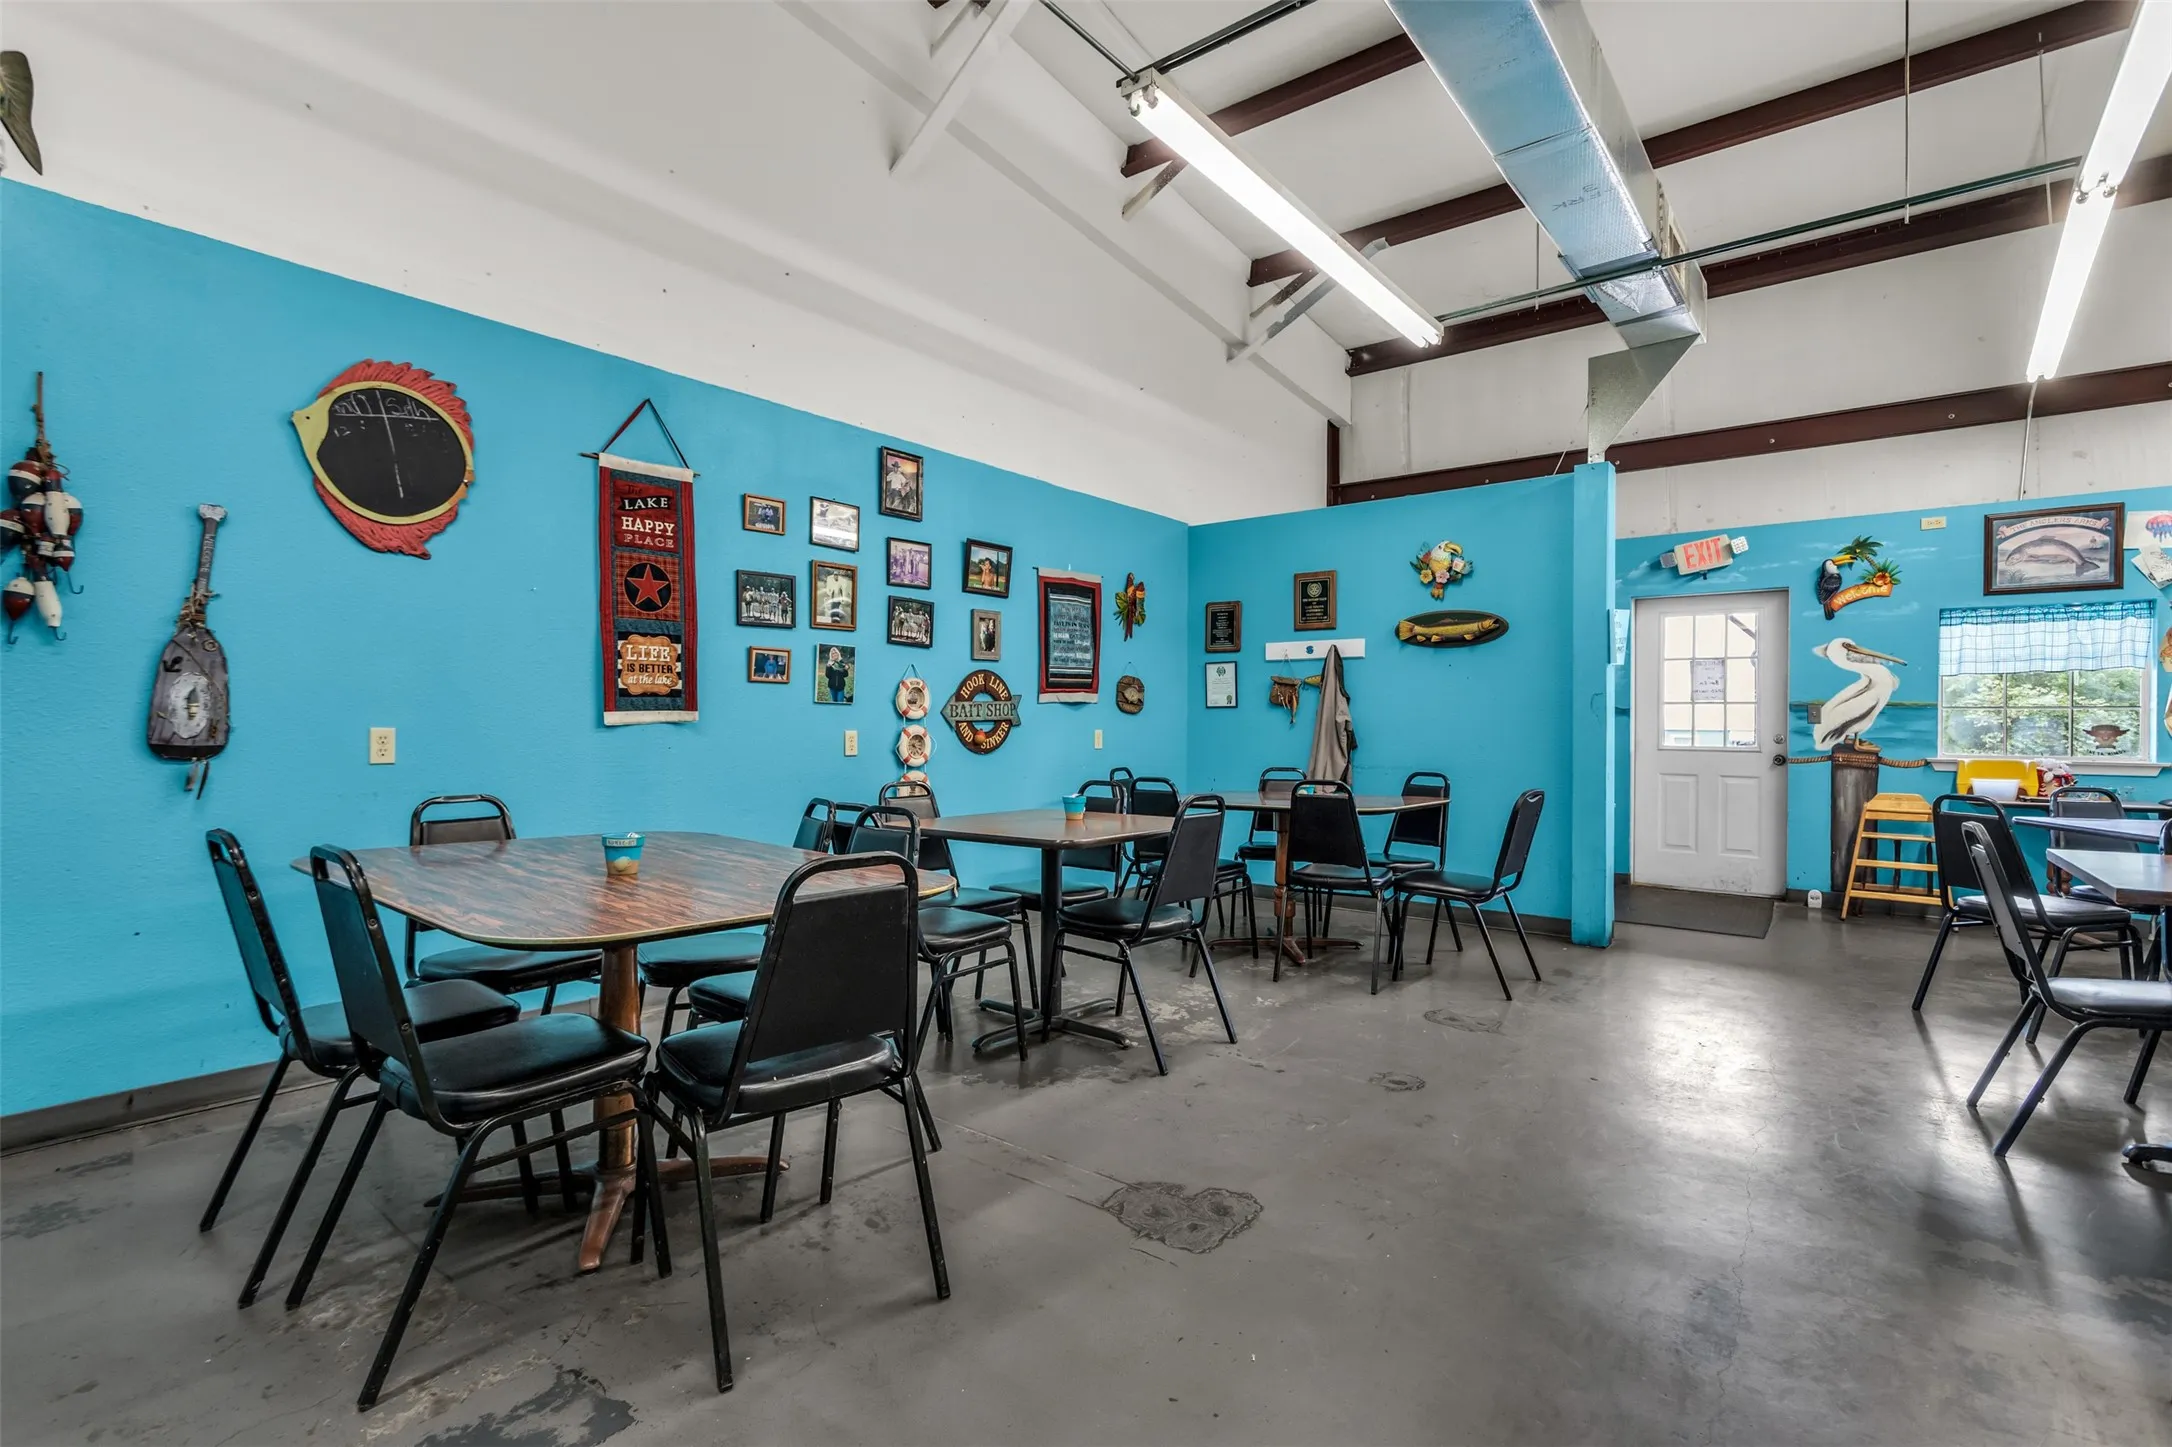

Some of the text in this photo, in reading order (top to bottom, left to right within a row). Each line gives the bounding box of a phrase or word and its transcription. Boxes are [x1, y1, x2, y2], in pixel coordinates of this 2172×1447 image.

[624, 497, 669, 510] LAKE
[621, 516, 675, 536] HAPPY
[2074, 517, 2098, 527] ARMS
[623, 533, 674, 548] PLACE
[1683, 538, 1723, 569] EXIT
[1833, 585, 1888, 605] Welcome
[625, 644, 671, 662] LIFE
[626, 663, 673, 674] IS BETTER
[628, 673, 673, 686] at the lake
[960, 673, 1009, 700] HOOK LINE
[949, 702, 1017, 718] BAIT SHOP
[958, 721, 1010, 749] AND SINKER
